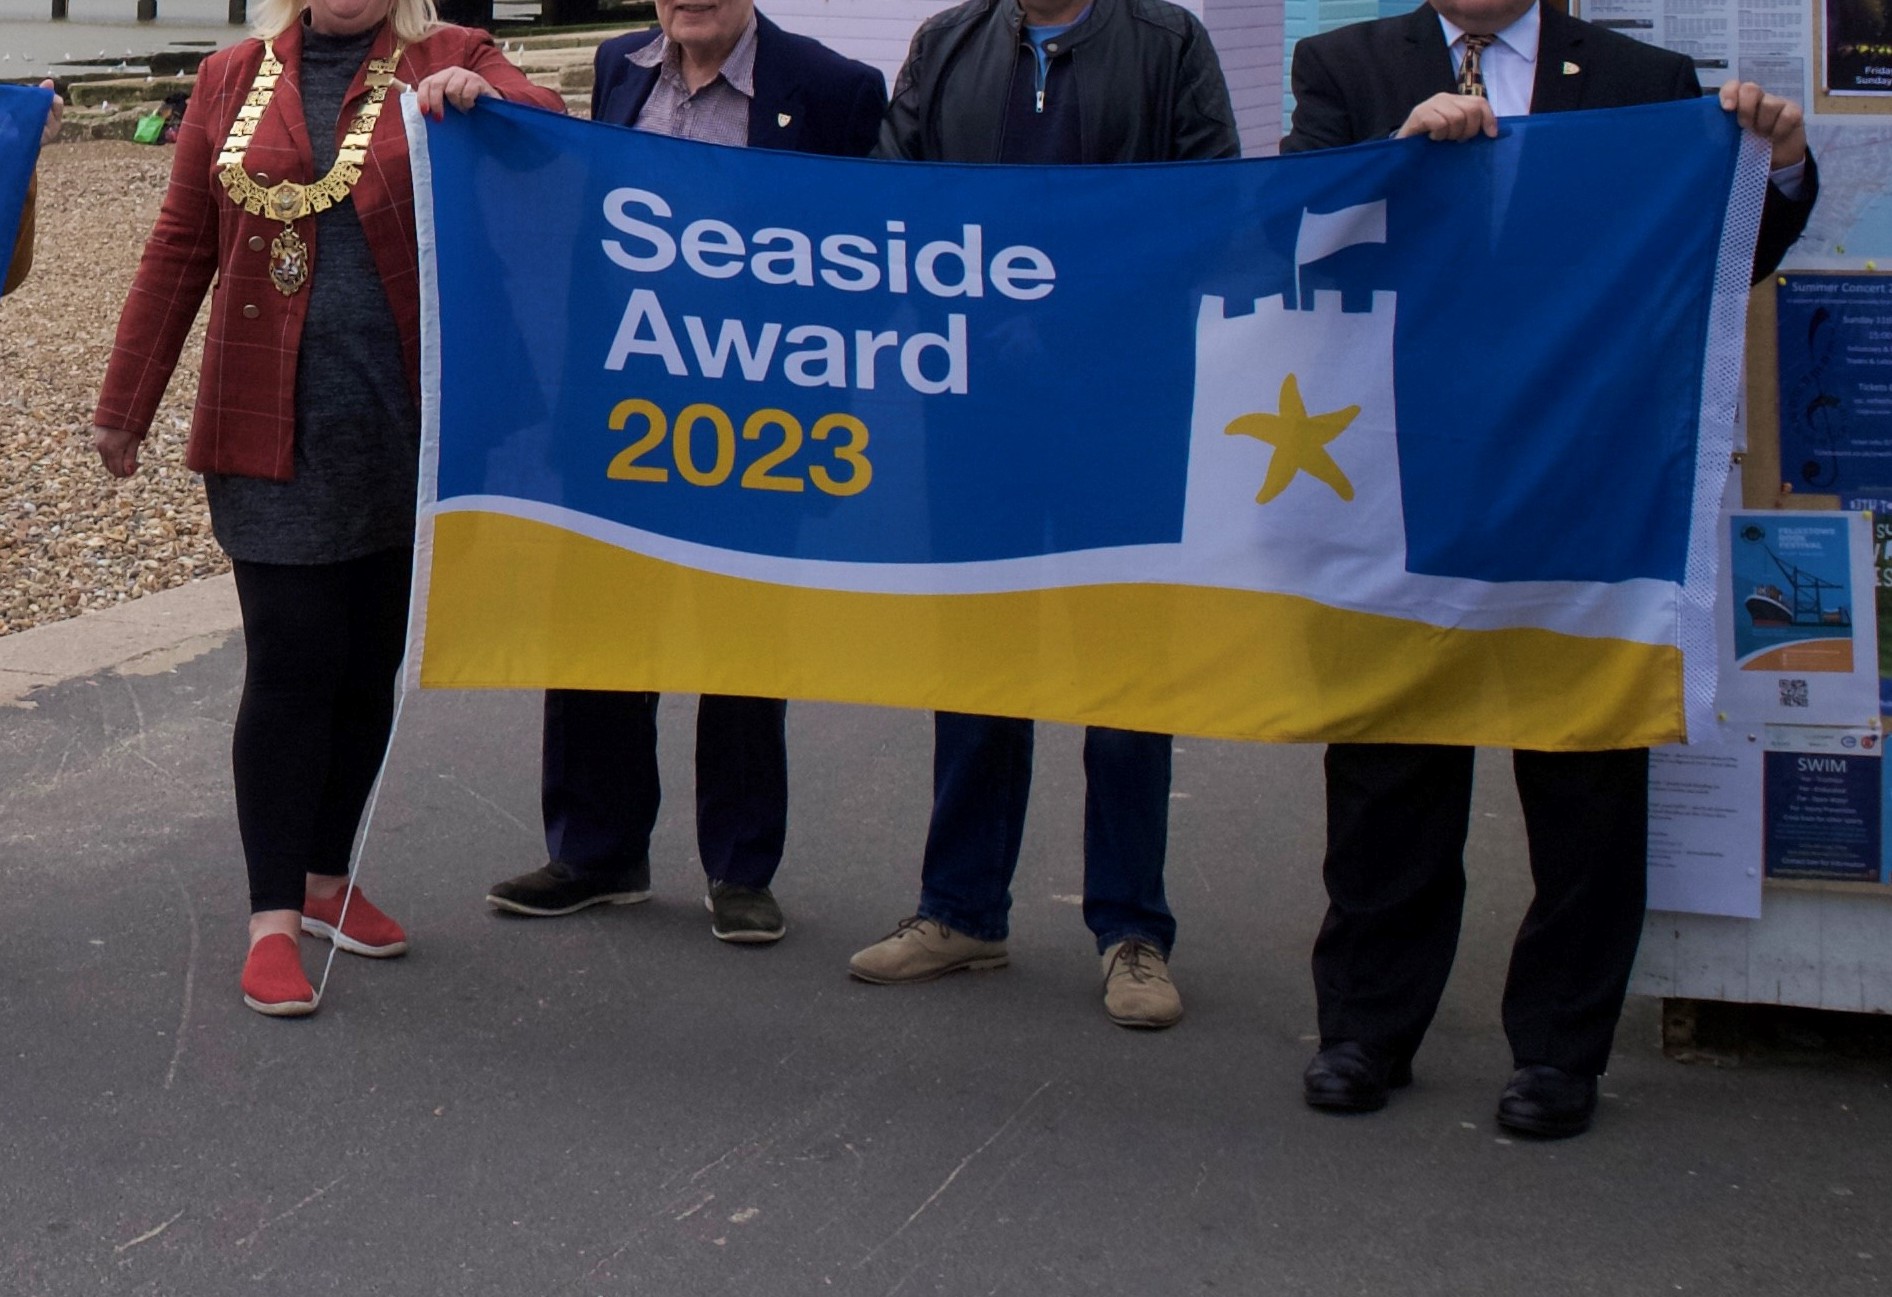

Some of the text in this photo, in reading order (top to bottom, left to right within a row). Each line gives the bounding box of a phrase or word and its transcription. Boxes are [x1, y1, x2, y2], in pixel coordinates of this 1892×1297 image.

[601, 187, 1056, 301] Seaside
[1792, 282, 1839, 293] Summer
[1841, 282, 1886, 293] Concert
[604, 289, 968, 395] Award
[607, 398, 872, 496] 2023
[1798, 757, 1846, 773] SWIM
